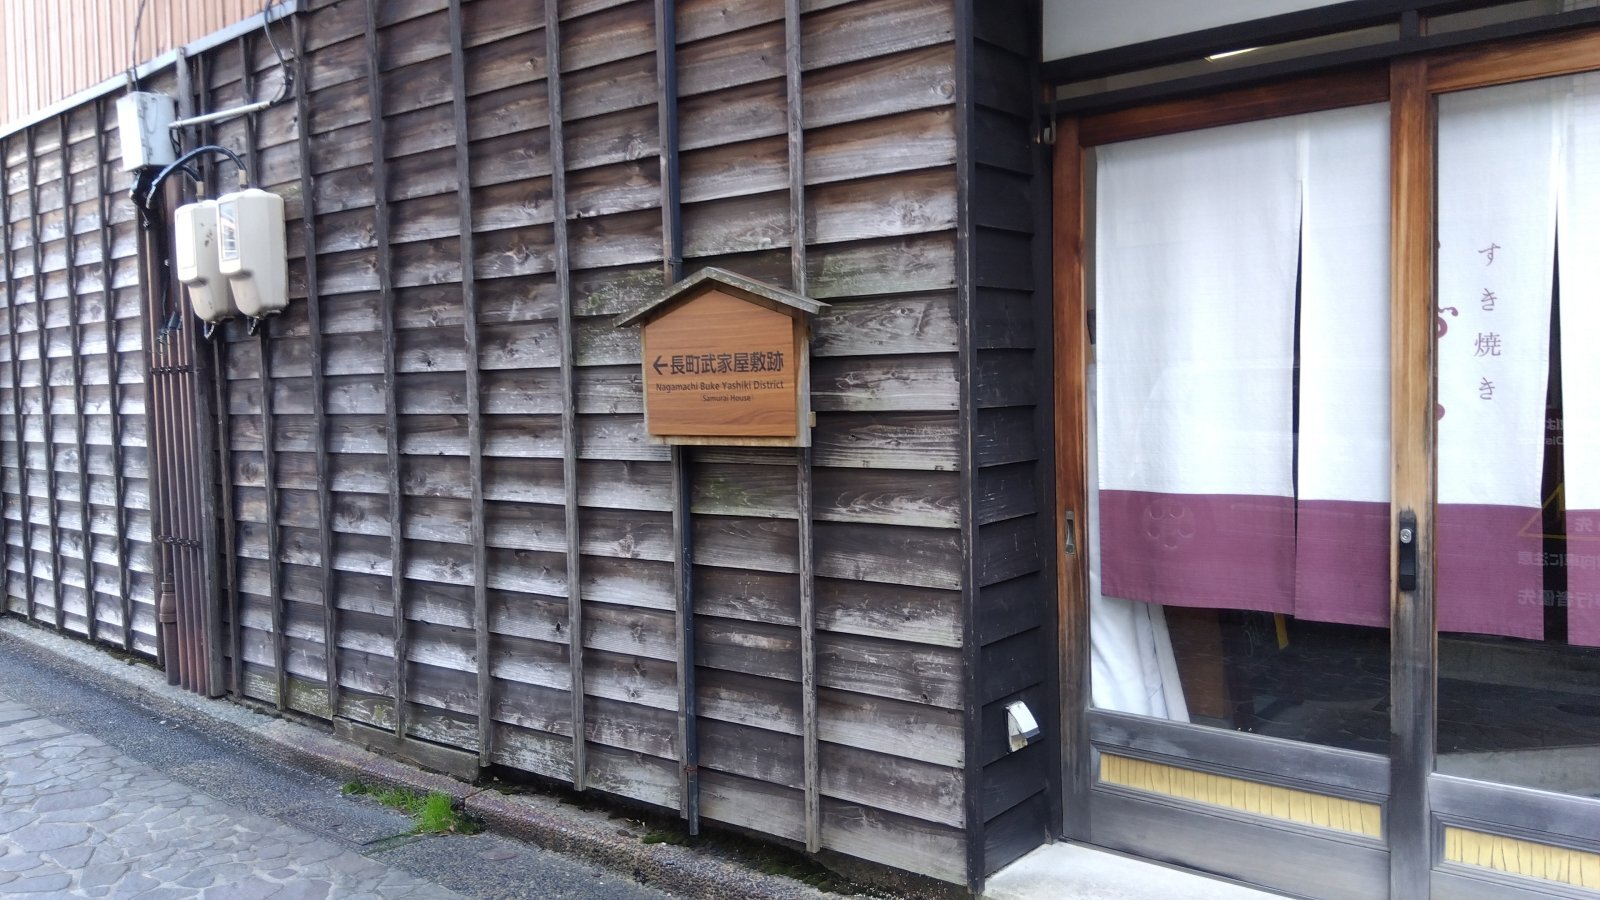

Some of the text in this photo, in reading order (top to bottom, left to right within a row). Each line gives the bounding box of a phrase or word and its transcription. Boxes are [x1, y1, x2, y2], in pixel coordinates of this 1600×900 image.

[1474, 242, 1502, 400] すき焼き
[670, 351, 784, 375] 長町武家屋敷跡
[656, 379, 784, 393] Nagamachi Buke Yashiki District
[702, 394, 751, 402] Samurai House
